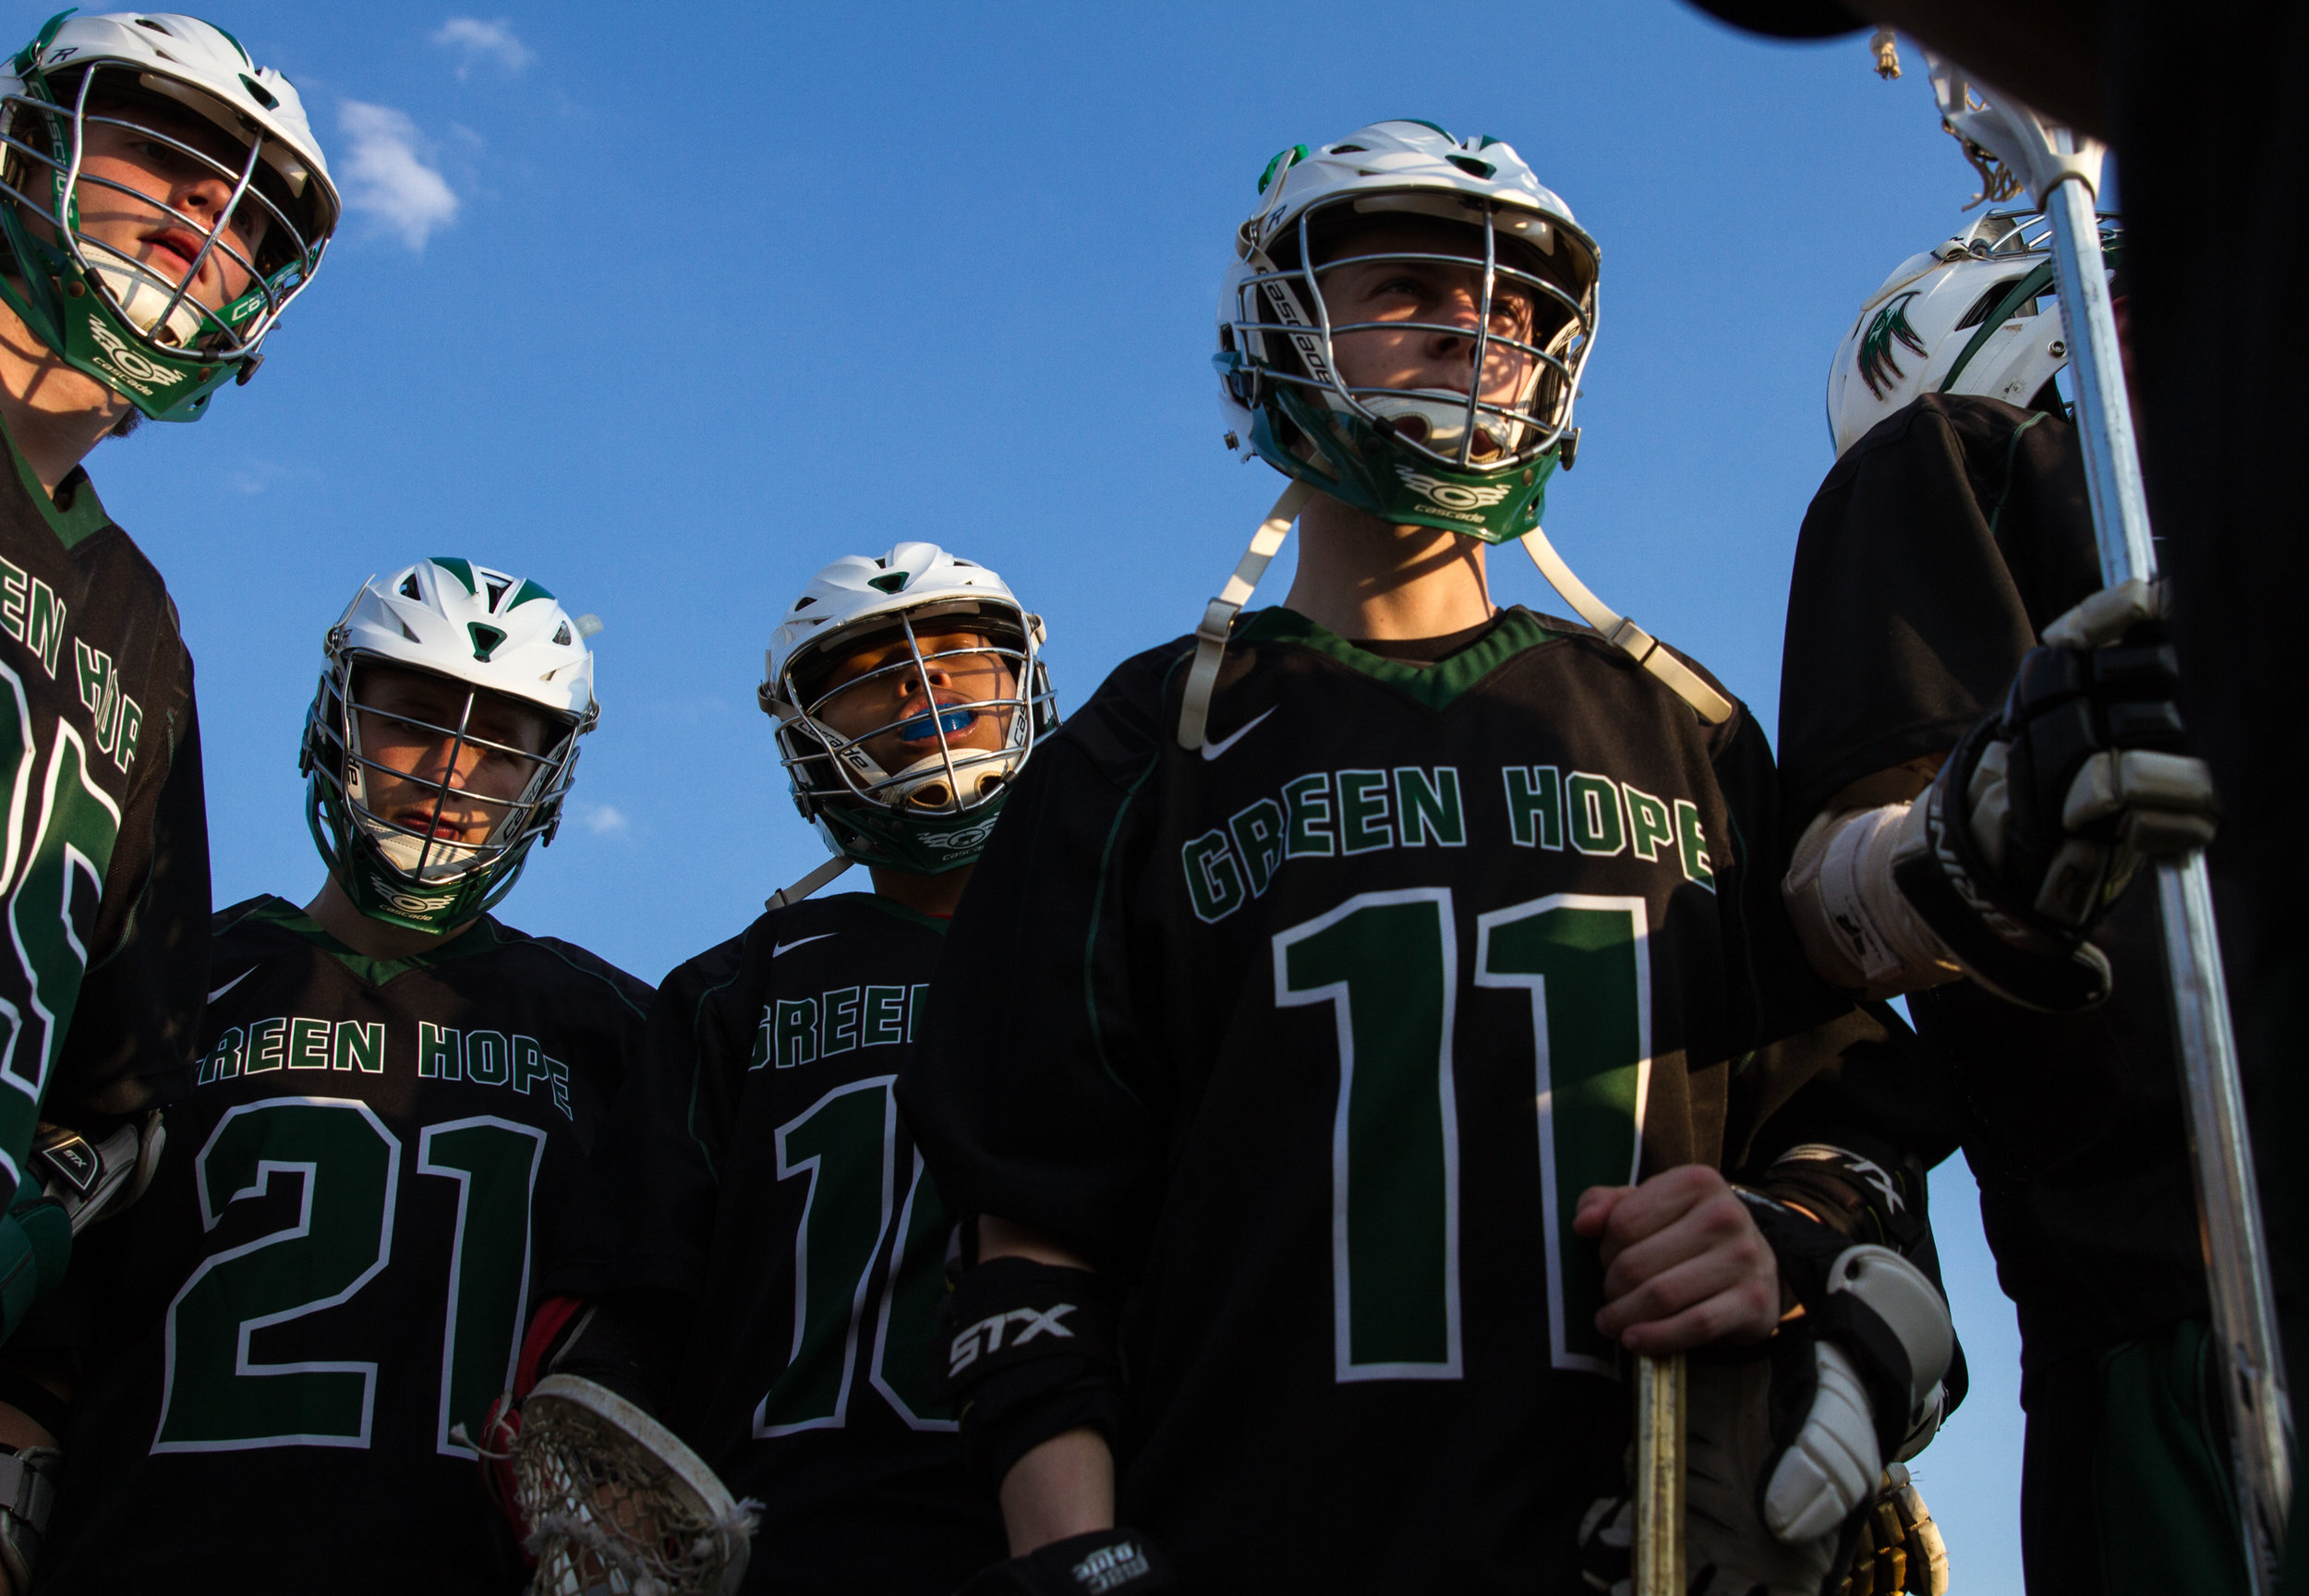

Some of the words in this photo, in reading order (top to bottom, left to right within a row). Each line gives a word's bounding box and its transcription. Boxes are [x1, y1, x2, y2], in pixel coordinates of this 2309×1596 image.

[1413, 502, 1487, 524] cascade
[1181, 766, 1468, 924] GREEN
[1502, 765, 1717, 896] HOPE
[195, 1016, 386, 1086] REEN
[418, 1021, 574, 1122] HOPE
[62, 1148, 88, 1168] STX
[1271, 886, 1652, 1384] 11
[148, 1095, 548, 1461] 21
[948, 1302, 1079, 1380] STX
